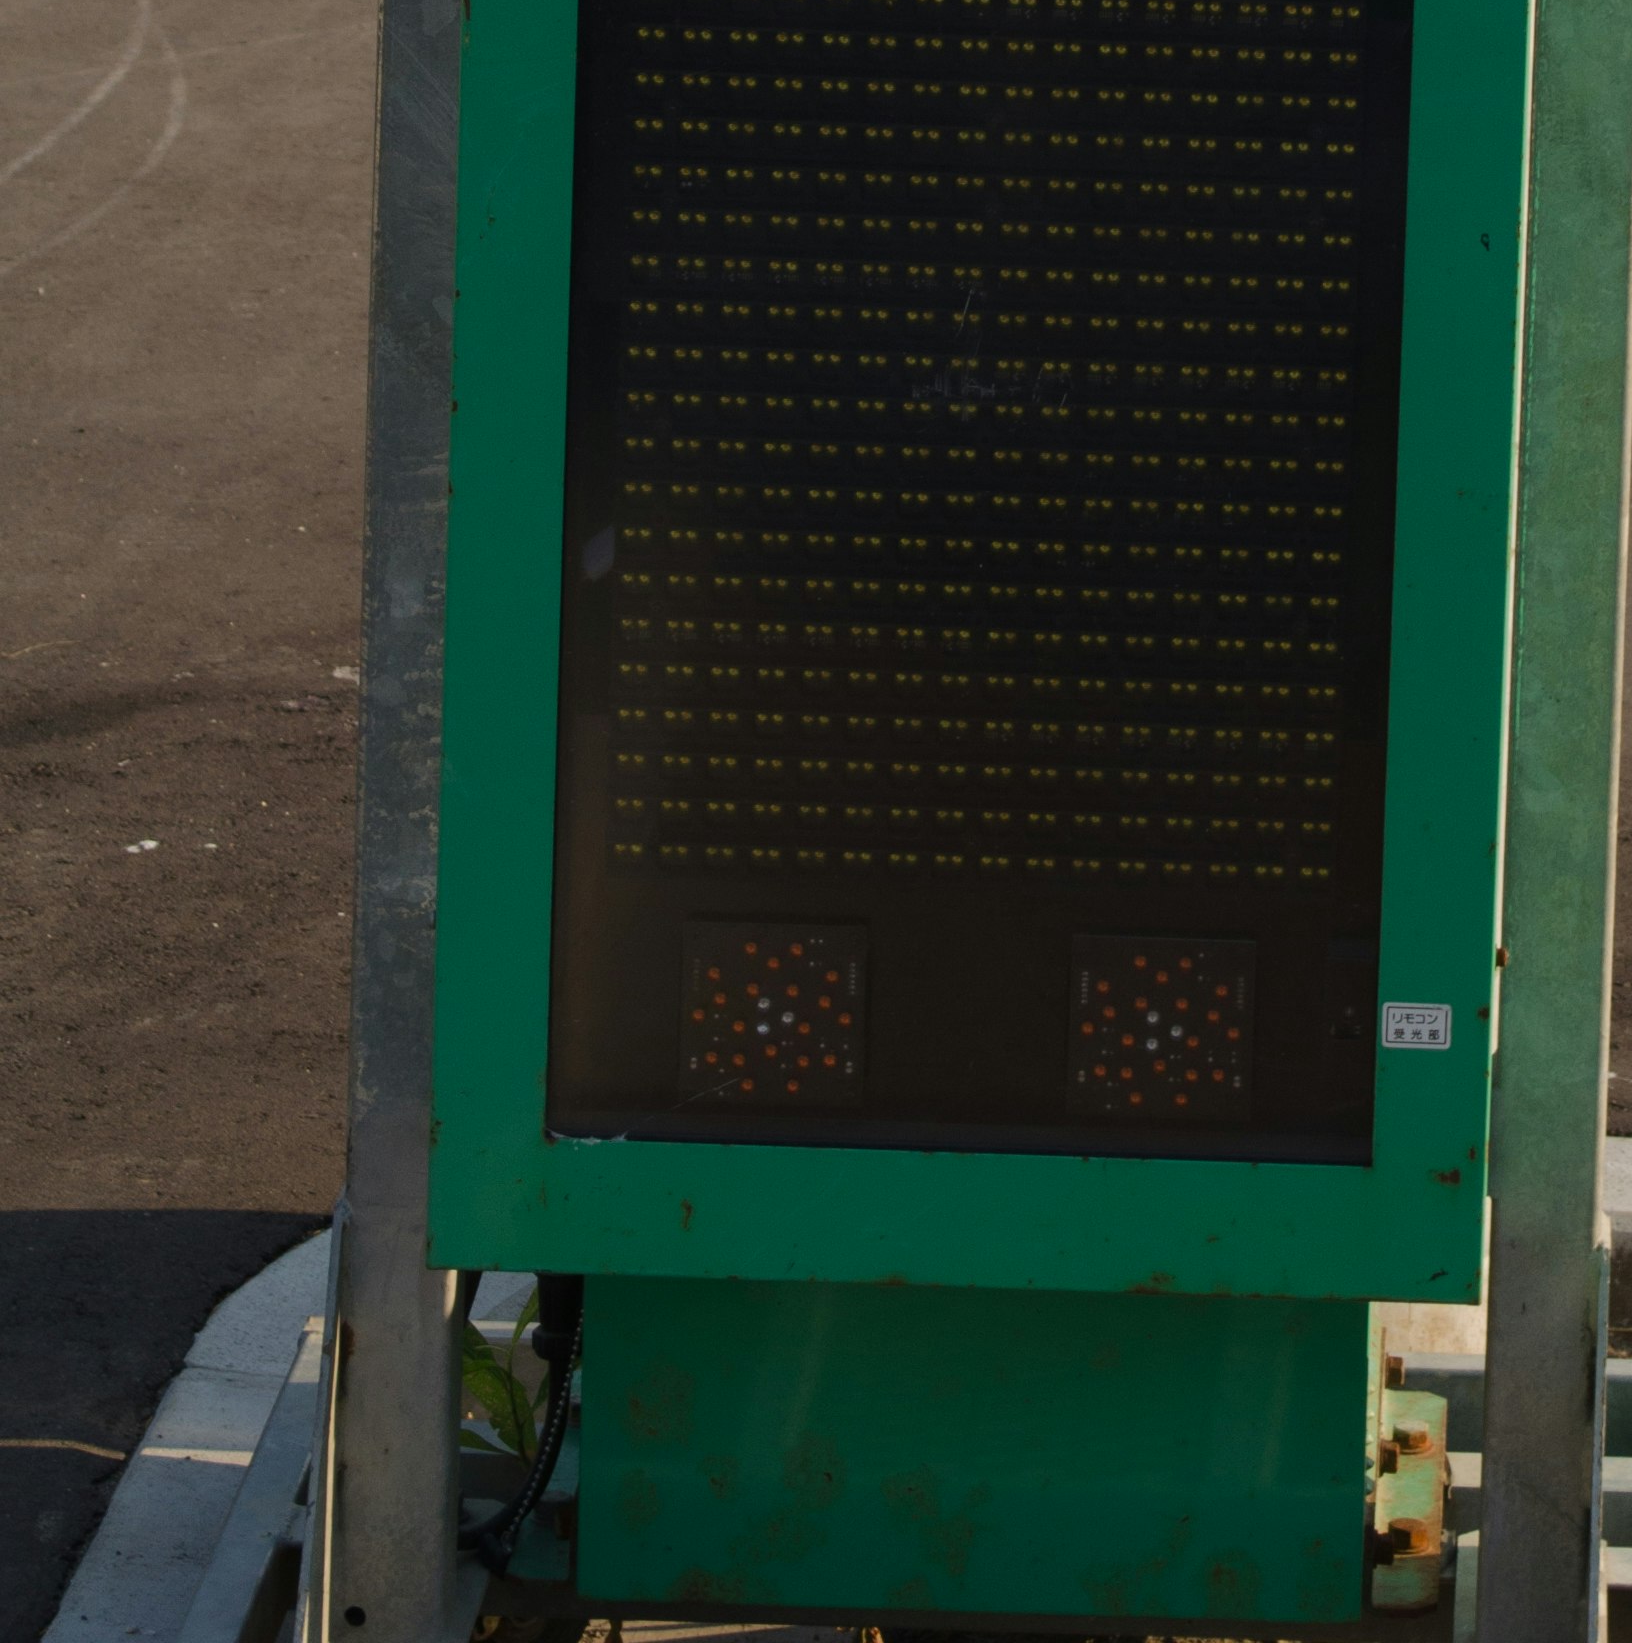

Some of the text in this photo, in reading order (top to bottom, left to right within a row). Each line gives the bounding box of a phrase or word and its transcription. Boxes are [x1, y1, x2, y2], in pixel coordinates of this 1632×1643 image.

[1392, 1013, 1439, 1025] リモコン
[1393, 1028, 1440, 1041] 受光部
